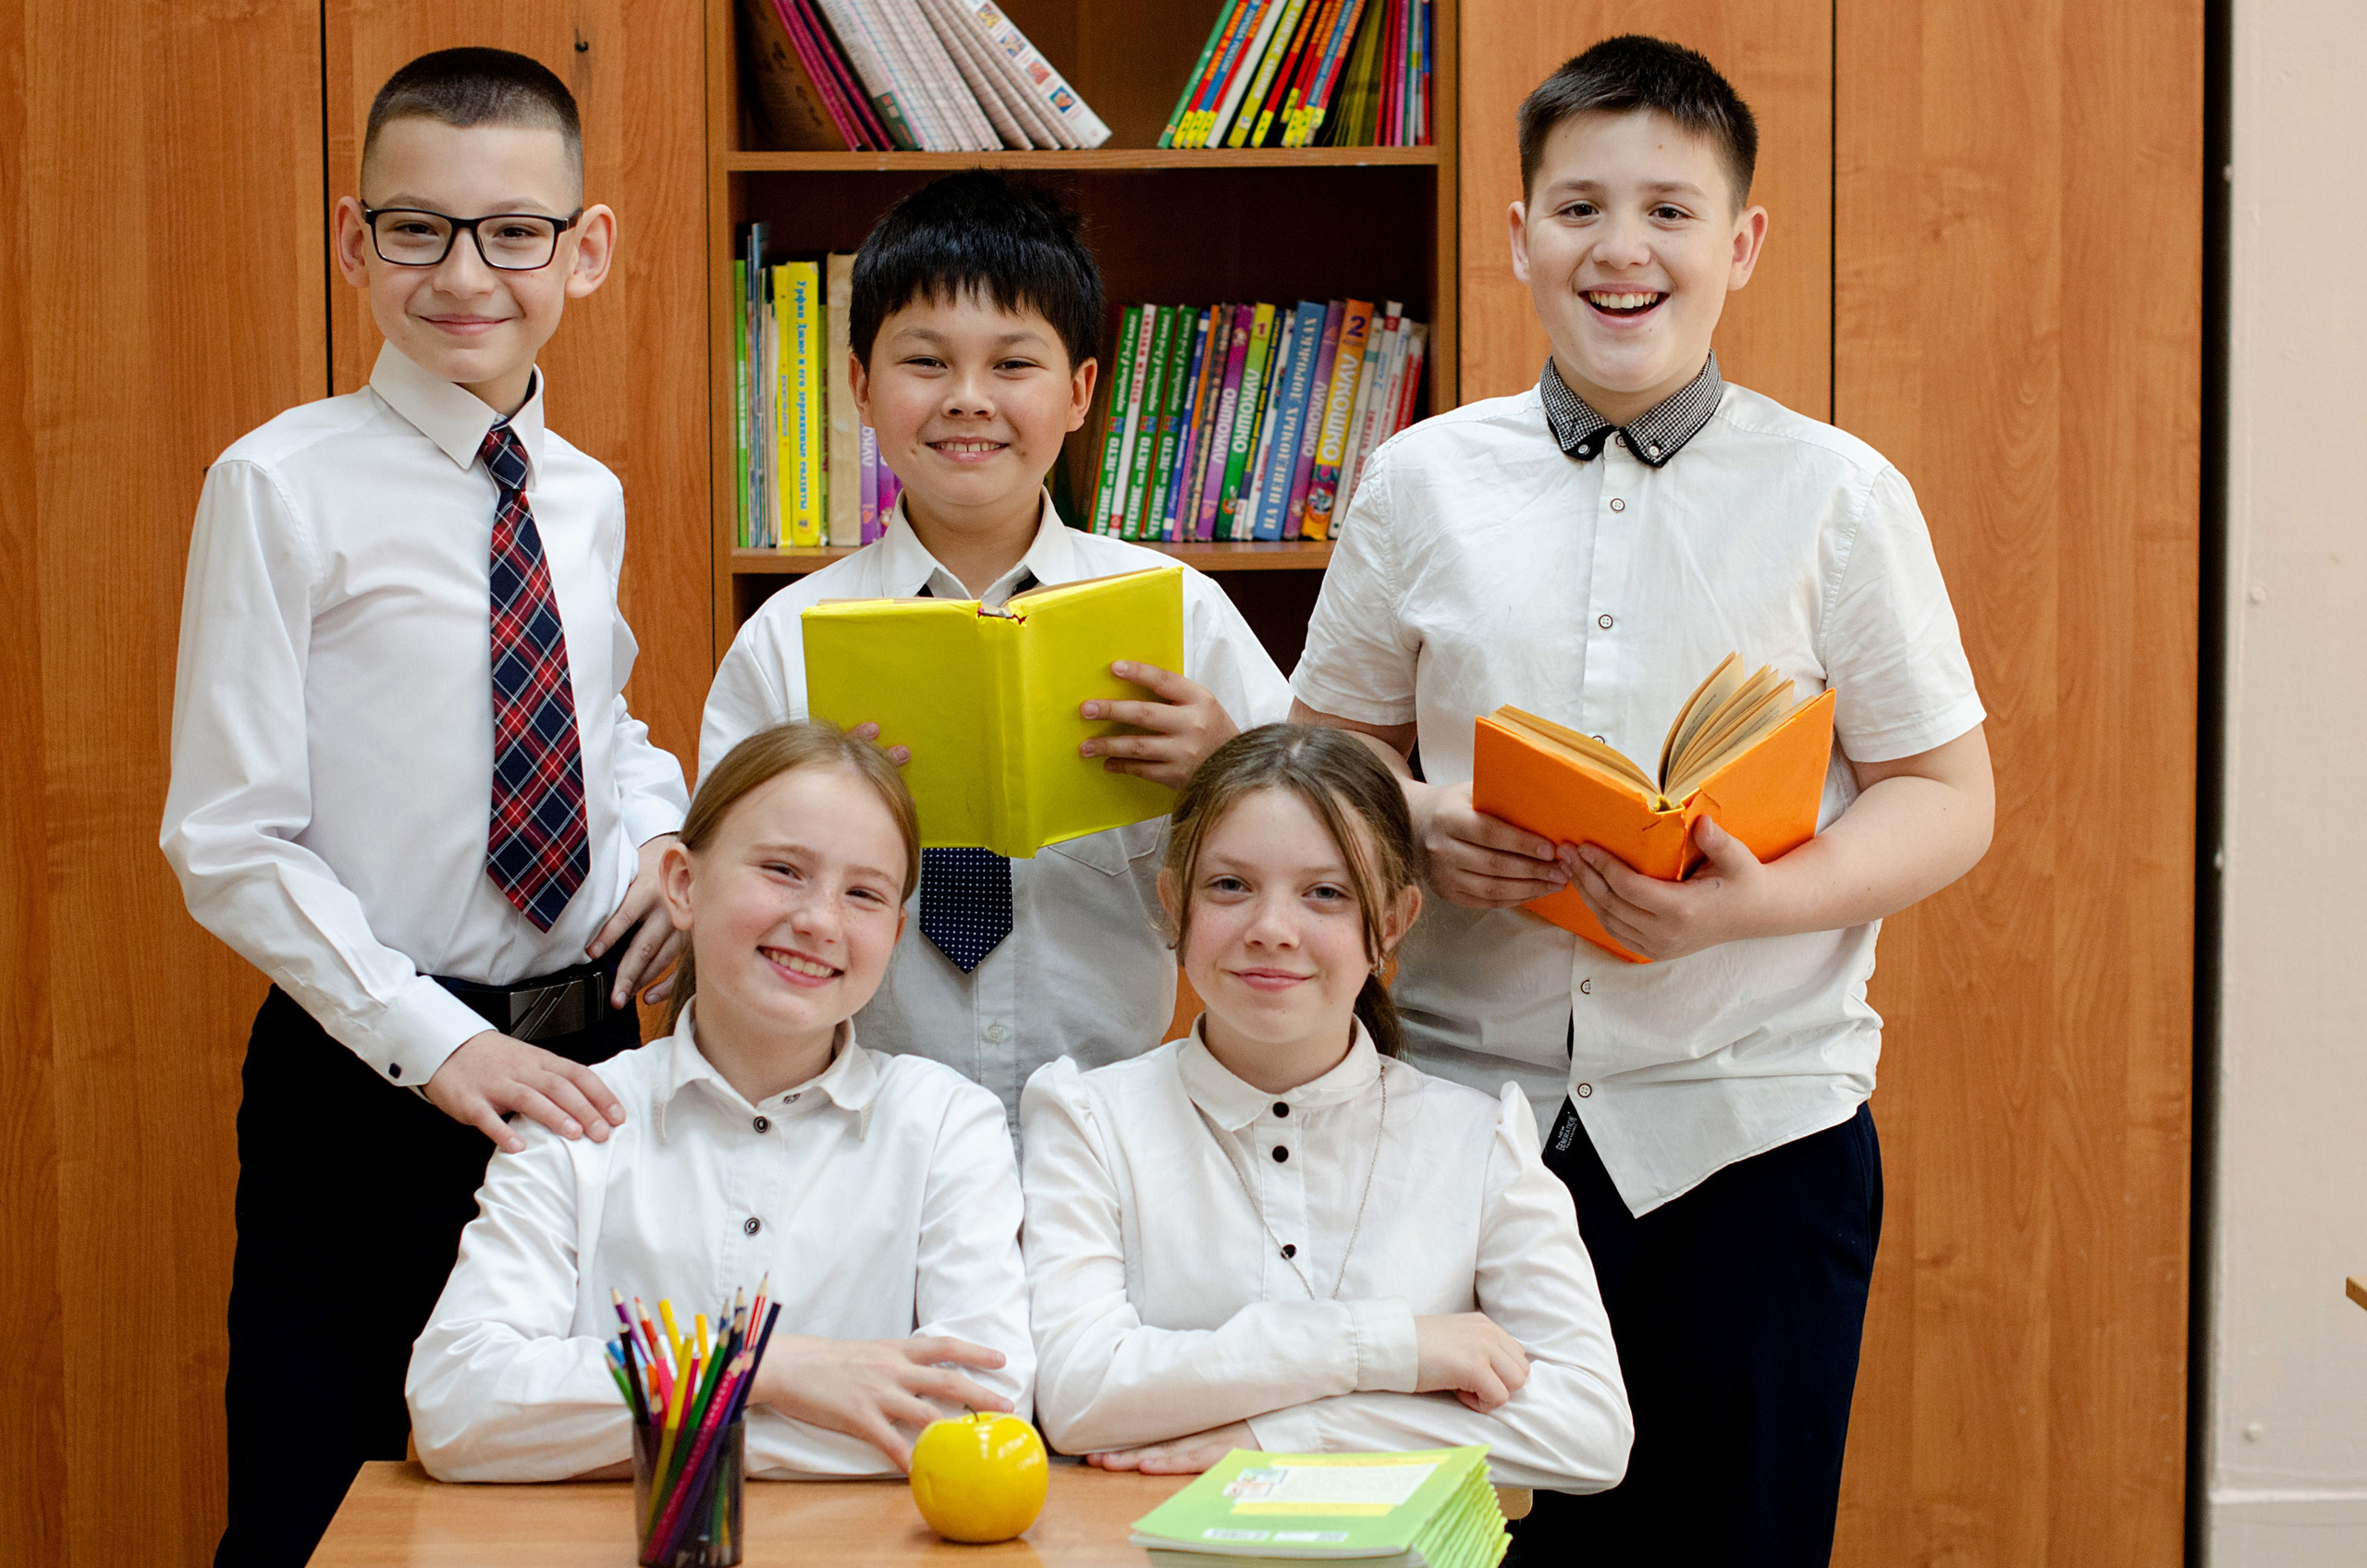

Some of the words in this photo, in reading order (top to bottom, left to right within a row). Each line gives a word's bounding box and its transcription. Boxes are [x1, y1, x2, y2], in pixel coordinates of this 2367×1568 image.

[794, 280, 806, 317] Урфин
[795, 323, 806, 354] Джюс
[1257, 322, 1266, 335] 1
[1348, 315, 1365, 337] 2
[1288, 316, 1317, 402] ДОРОЖКАХ
[1112, 365, 1130, 412] переходим
[1144, 365, 1161, 410] переходим
[1167, 365, 1185, 410] переходим
[1231, 368, 1262, 453] ЛУКОШКО
[1319, 352, 1359, 462] ЛУКОШКО
[796, 391, 806, 457] деревянные
[1210, 386, 1237, 464] ЛУКОШКО
[1301, 380, 1328, 458] ЛУКОШКО
[862, 427, 874, 466] ЛУКО
[1268, 405, 1299, 504] НЕВЕДОМЫХ
[798, 461, 807, 509] солдаты
[1095, 485, 1112, 535] ЧТЕНИЕ
[1104, 436, 1120, 472] ЛЕТО
[1124, 484, 1143, 536] ЧТЕНИЕ
[1135, 435, 1150, 471] ЛЕТО
[1147, 484, 1166, 536] ЧТЕНИЕ
[1158, 435, 1173, 470] ЛЕТО
[1263, 507, 1279, 529] НА
[1556, 1116, 1577, 1152] GENERATION
